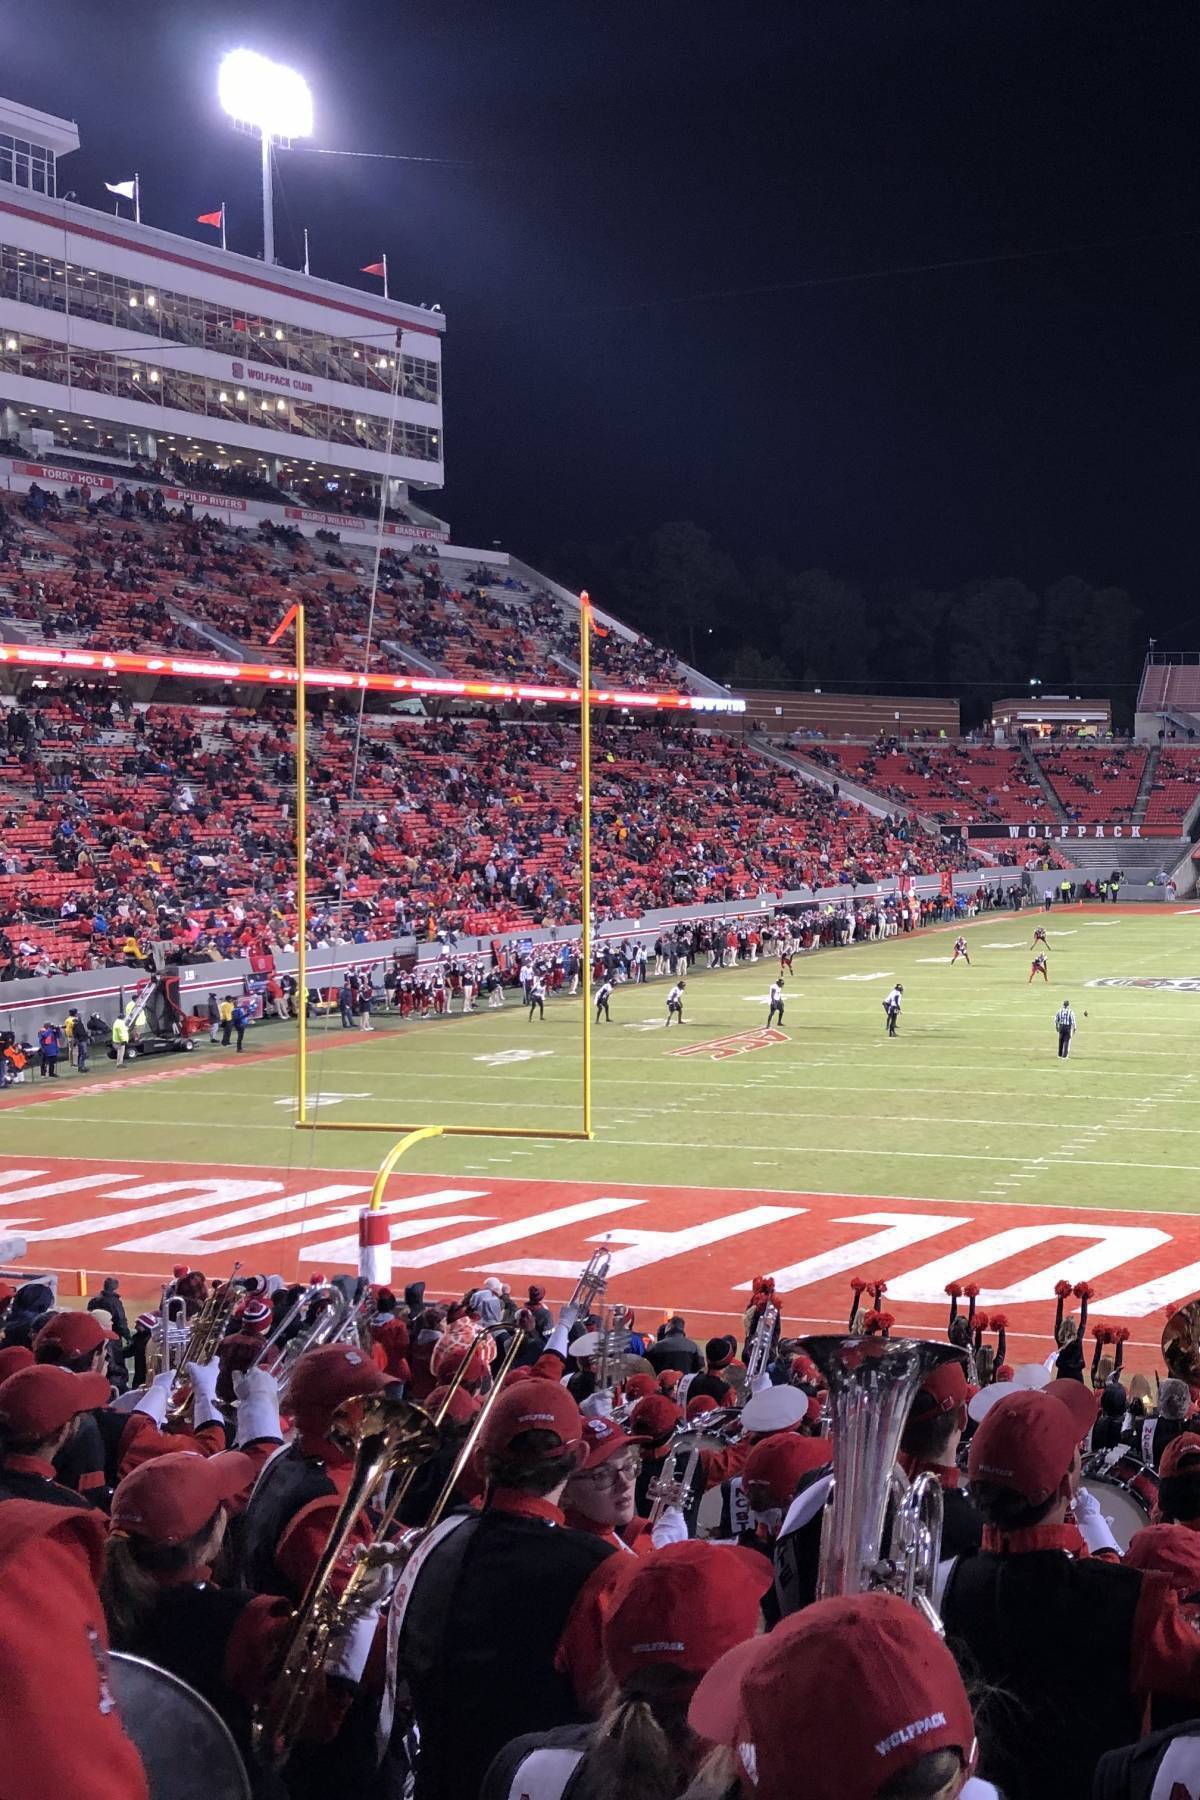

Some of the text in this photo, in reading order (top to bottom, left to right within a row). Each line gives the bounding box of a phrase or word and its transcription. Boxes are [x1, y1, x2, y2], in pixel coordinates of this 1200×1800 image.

[248, 368, 313, 392] WOLFPACK CLUB
[41, 468, 105, 487] TORRY HOLT
[177, 492, 243, 510] PHILIP RIVERS
[302, 511, 365, 529] MARIO WILLIAMS
[395, 526, 449, 541] BRADLEY CHUBB
[1008, 826, 1141, 838] WOLFPACK
[873, 1711, 948, 1758] WOLFPACK
